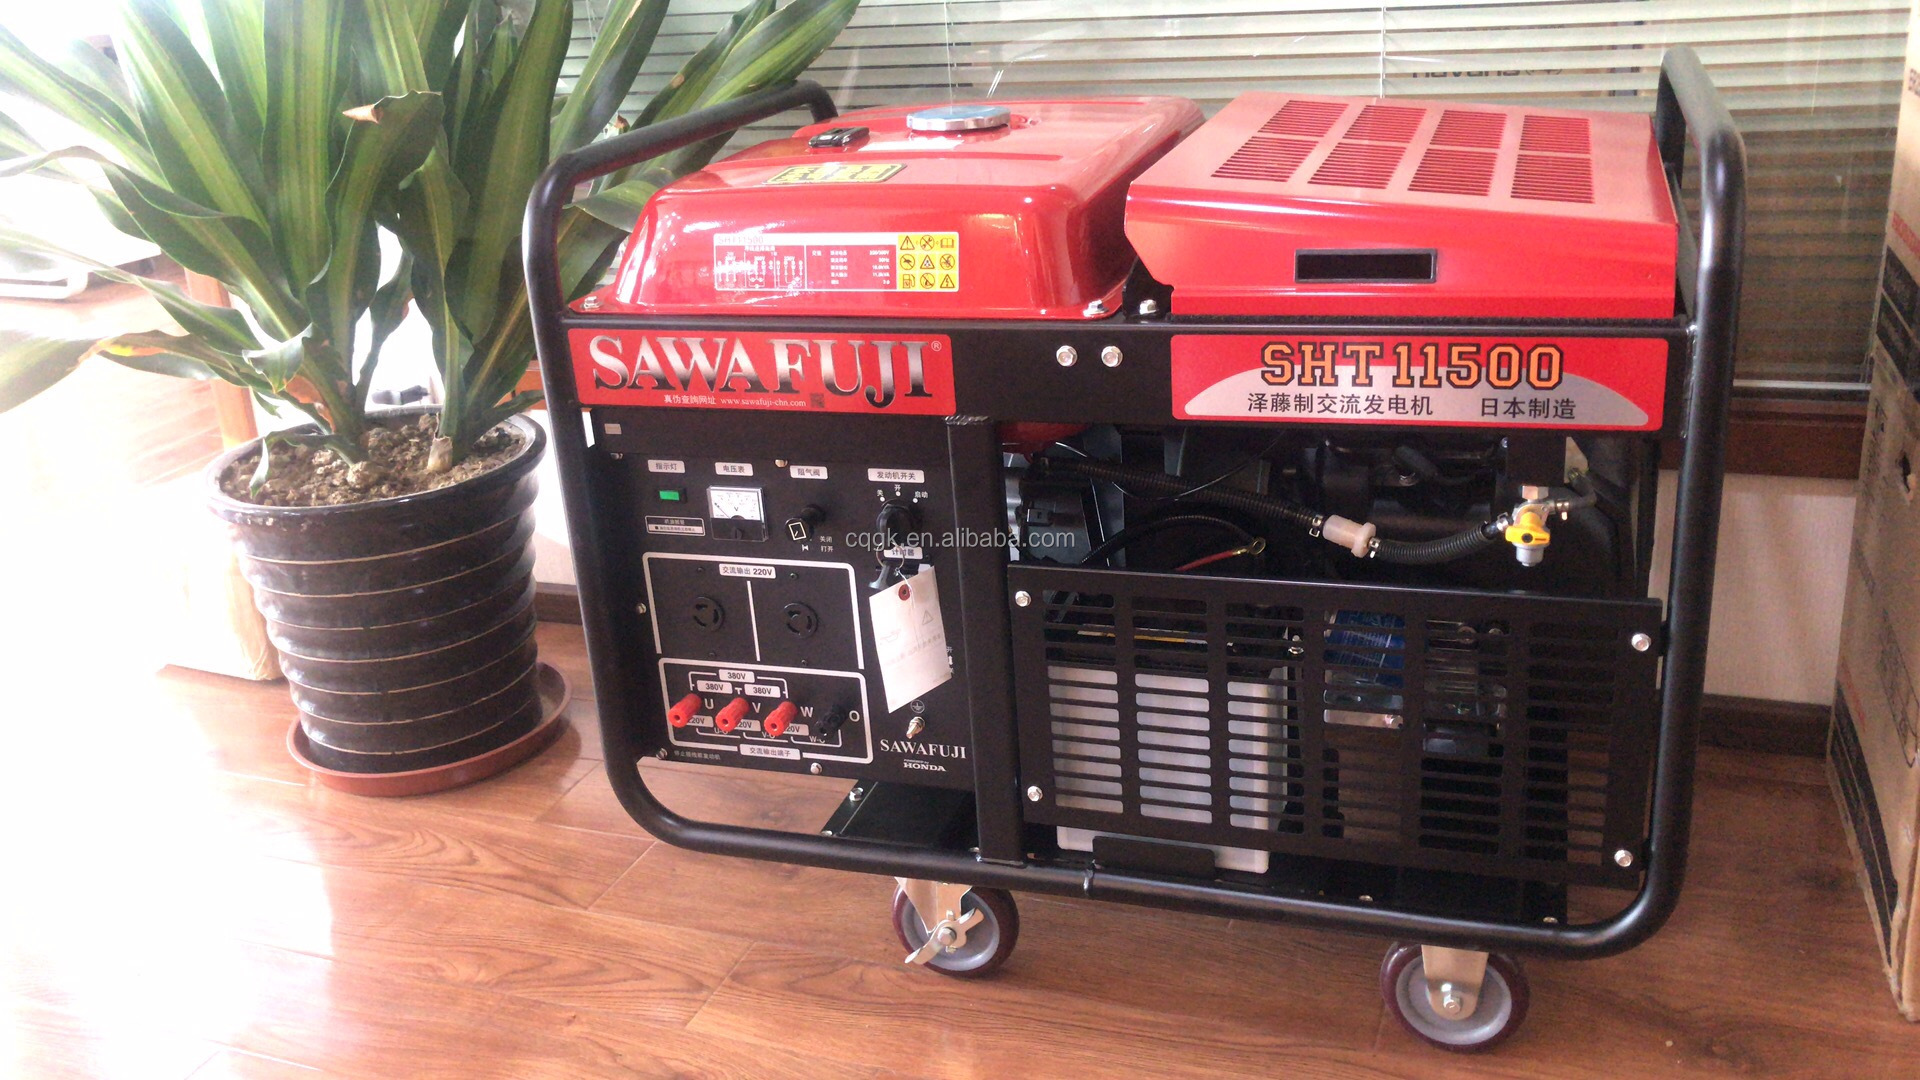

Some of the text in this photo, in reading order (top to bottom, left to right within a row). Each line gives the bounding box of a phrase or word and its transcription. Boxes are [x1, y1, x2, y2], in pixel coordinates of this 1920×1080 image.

[589, 334, 933, 409] SAWAFUJI
[719, 397, 807, 408] www.sawafuji-chn.com
[1247, 391, 1577, 420] 泽藤制交流发电机 日本制造
[655, 462, 677, 471] 指示灯
[722, 464, 745, 473] 电压表
[876, 471, 916, 481] 发动机开关
[722, 565, 773, 578] 交流输出 220V
[727, 672, 746, 681] 380V
[705, 683, 724, 691] 380V
[752, 686, 772, 695] 380V
[703, 698, 714, 710] U
[751, 702, 761, 714] V
[800, 706, 814, 718] W
[749, 746, 791, 758] 交流输出端子
[880, 739, 967, 759] SAWAFUJI
[903, 762, 947, 773] HONDA
